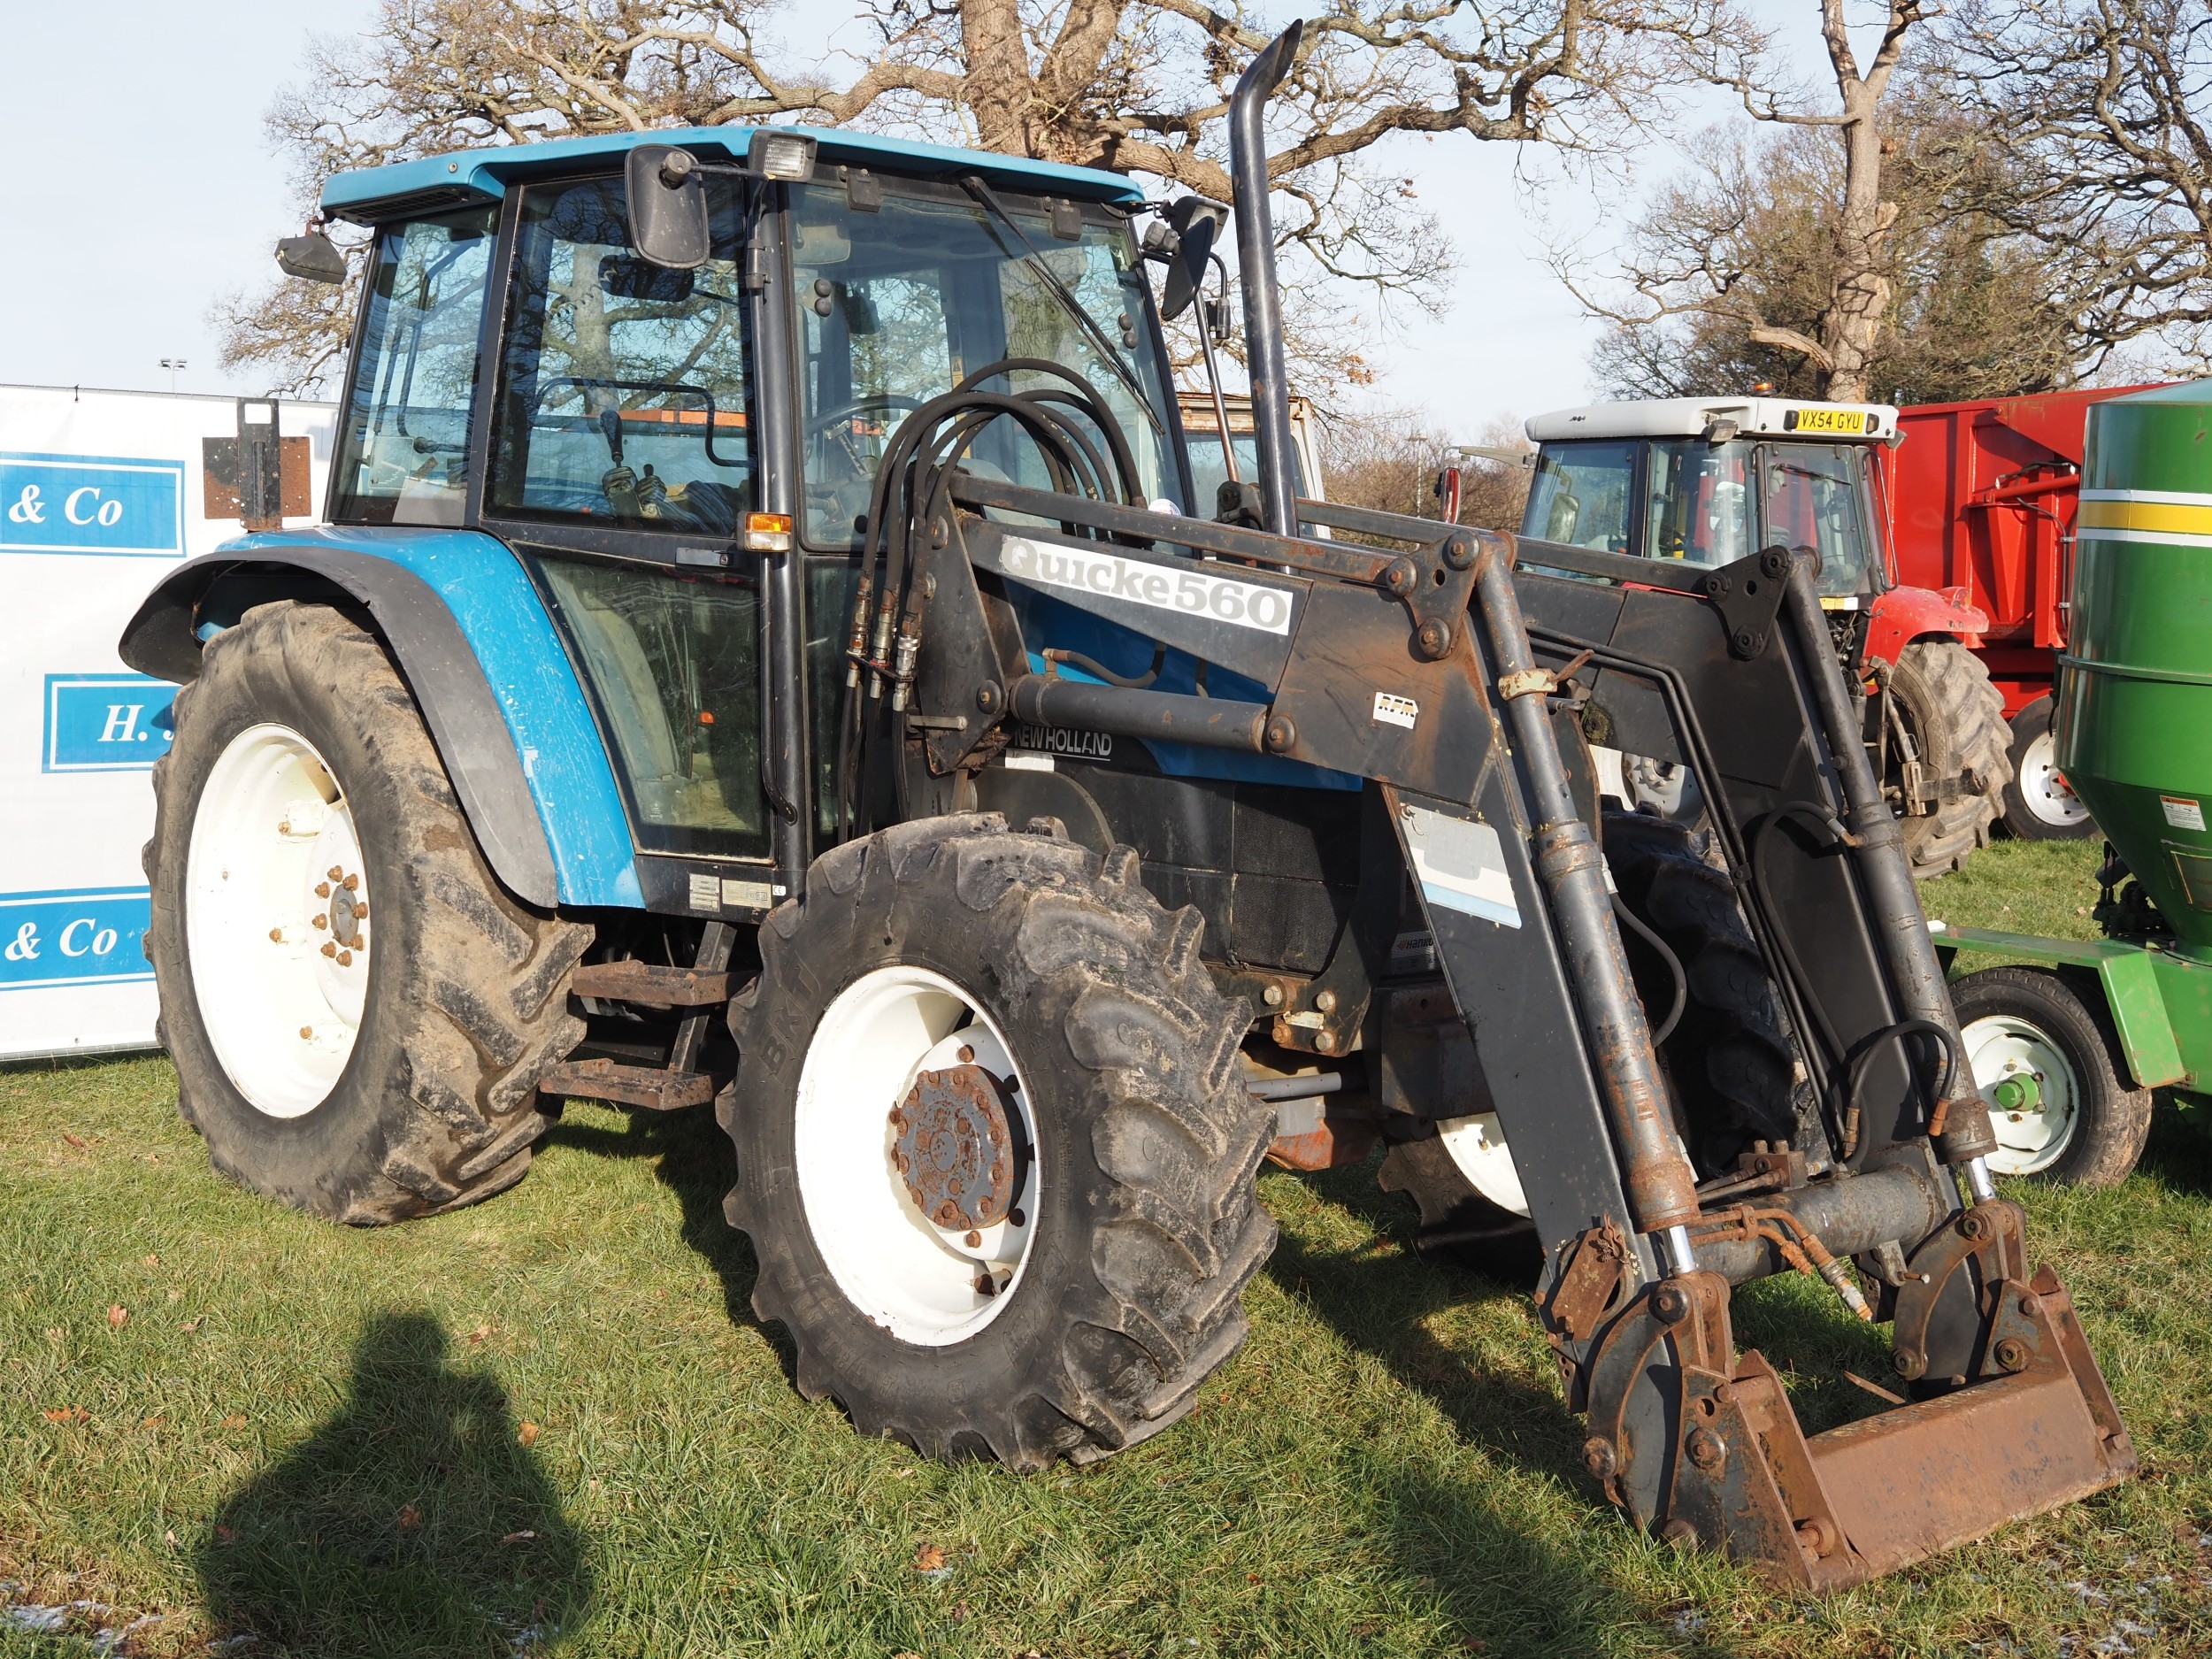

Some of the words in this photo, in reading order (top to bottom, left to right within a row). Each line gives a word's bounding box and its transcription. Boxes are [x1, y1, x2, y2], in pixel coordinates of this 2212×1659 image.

[1802, 411, 1832, 429] VX54
[1837, 412, 1862, 430] GYU
[8, 484, 46, 524] &
[65, 487, 123, 526] Co
[97, 704, 148, 741] H.
[1014, 726, 1044, 749] NEW
[1046, 727, 1112, 757] HOLLAND
[4, 922, 41, 961] &
[59, 918, 118, 957] Co
[760, 964, 817, 1078] BKT
